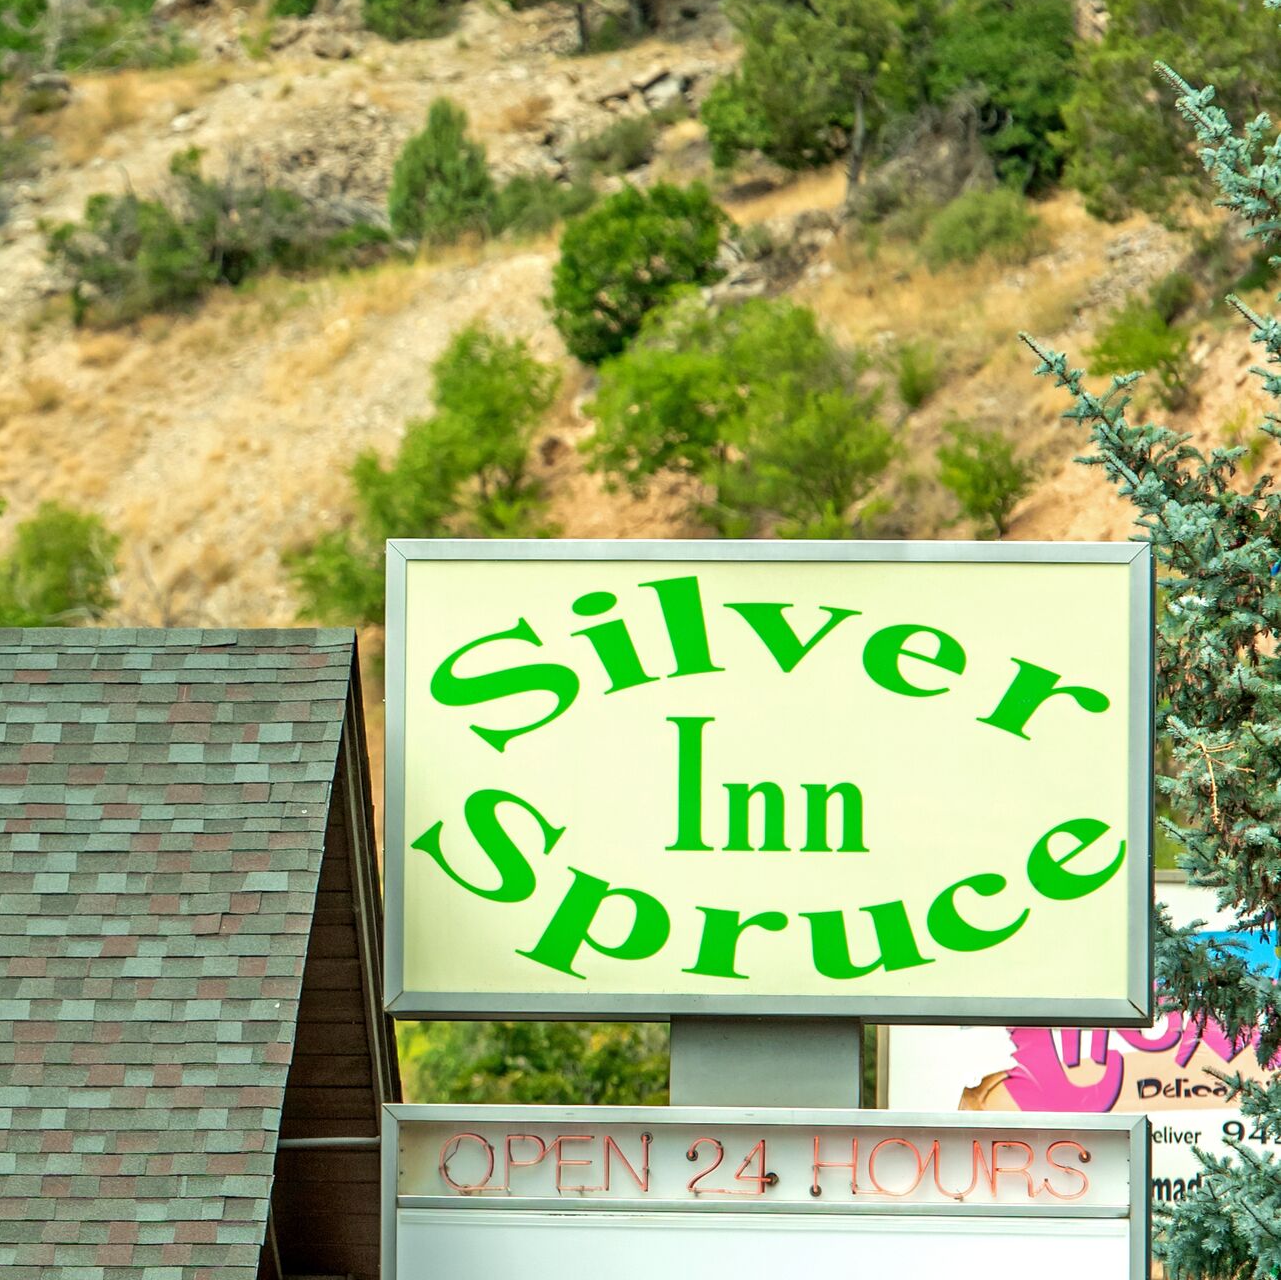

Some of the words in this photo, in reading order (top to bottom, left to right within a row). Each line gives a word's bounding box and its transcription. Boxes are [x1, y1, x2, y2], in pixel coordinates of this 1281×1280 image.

[430, 576, 1109, 752] Silver
[666, 717, 868, 852] Inn
[411, 789, 1125, 979] Spruce
[439, 1132, 650, 1194] OPEN
[686, 1136, 776, 1194] 24
[810, 1136, 1091, 1201] HOURS
